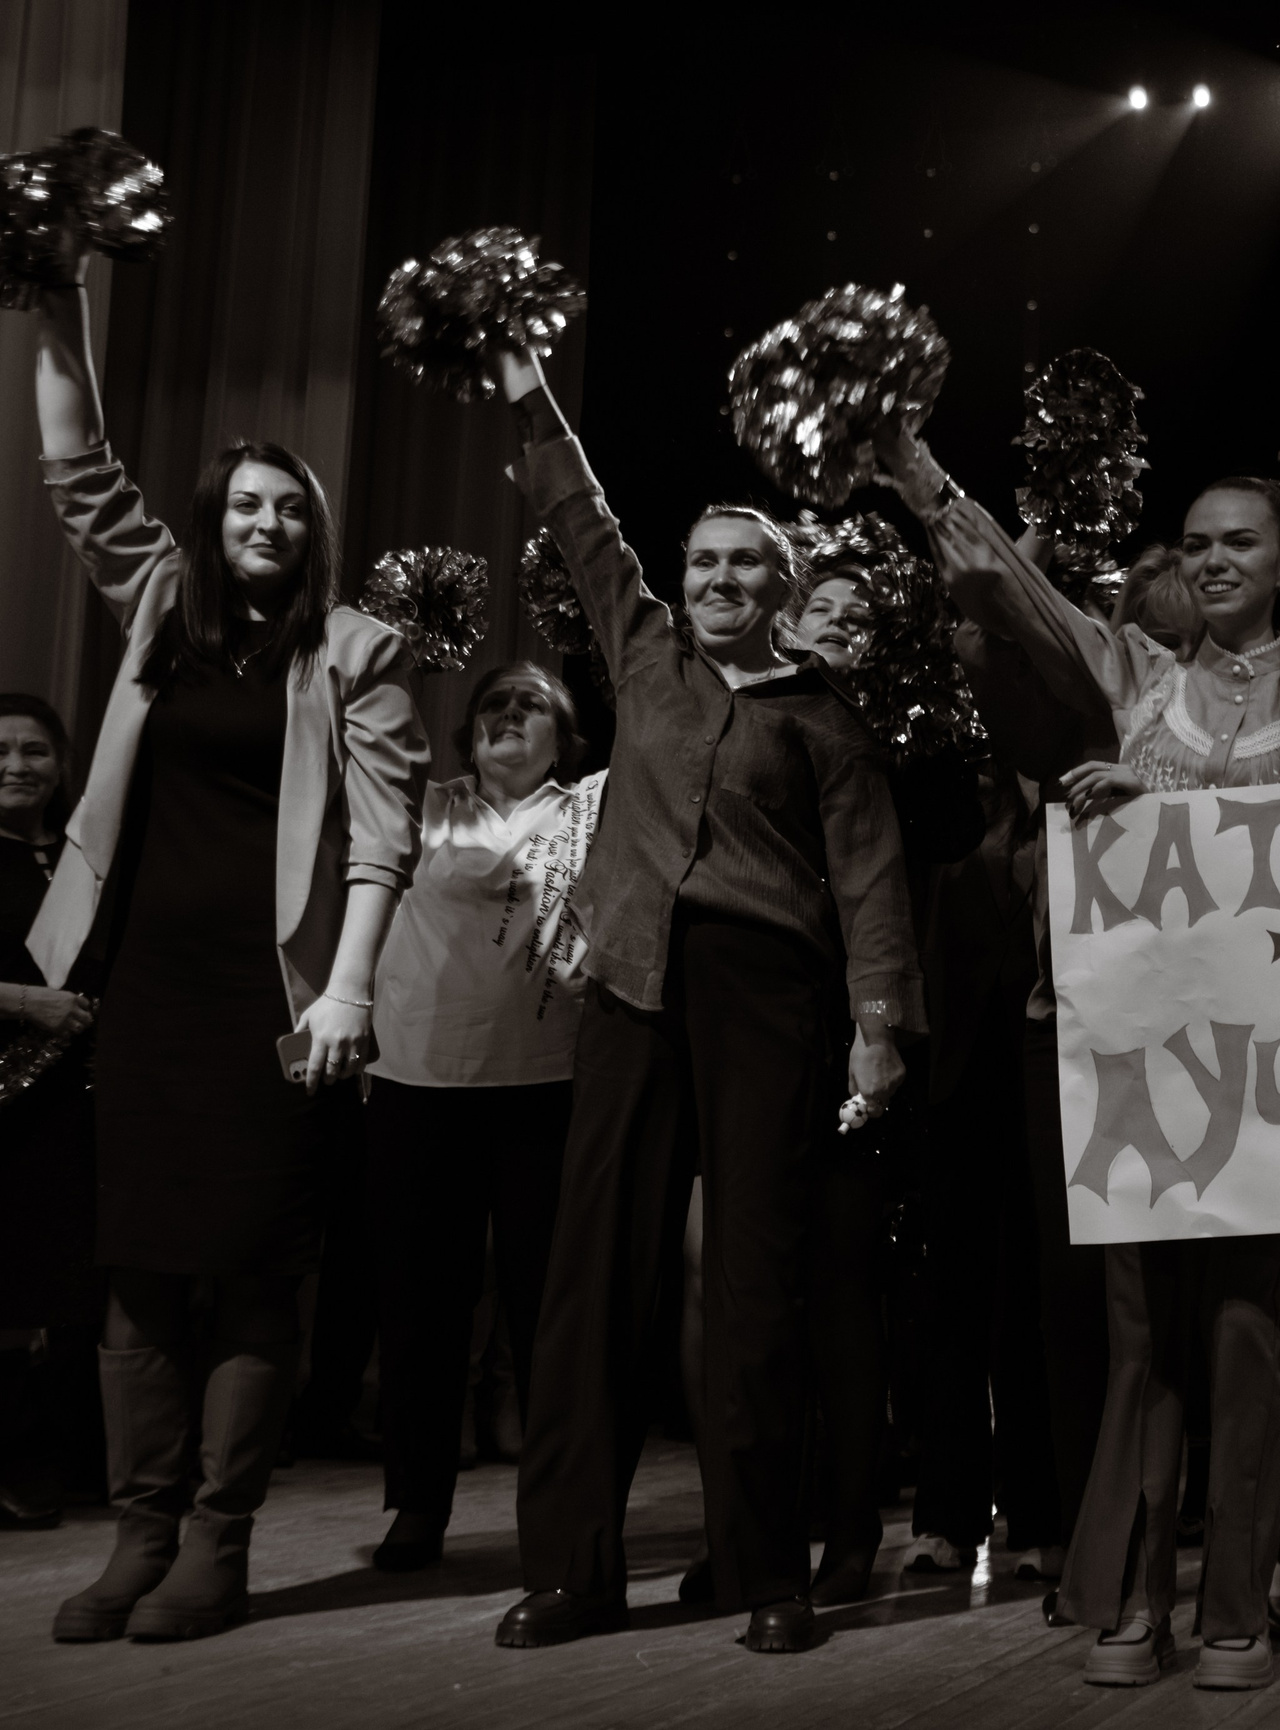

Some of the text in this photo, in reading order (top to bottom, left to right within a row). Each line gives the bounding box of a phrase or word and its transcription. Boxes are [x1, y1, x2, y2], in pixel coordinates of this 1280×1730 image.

[539, 858, 568, 916] Fashion
[492, 925, 508, 948] way
[536, 915, 544, 928] to
[525, 928, 545, 974] enlighten
